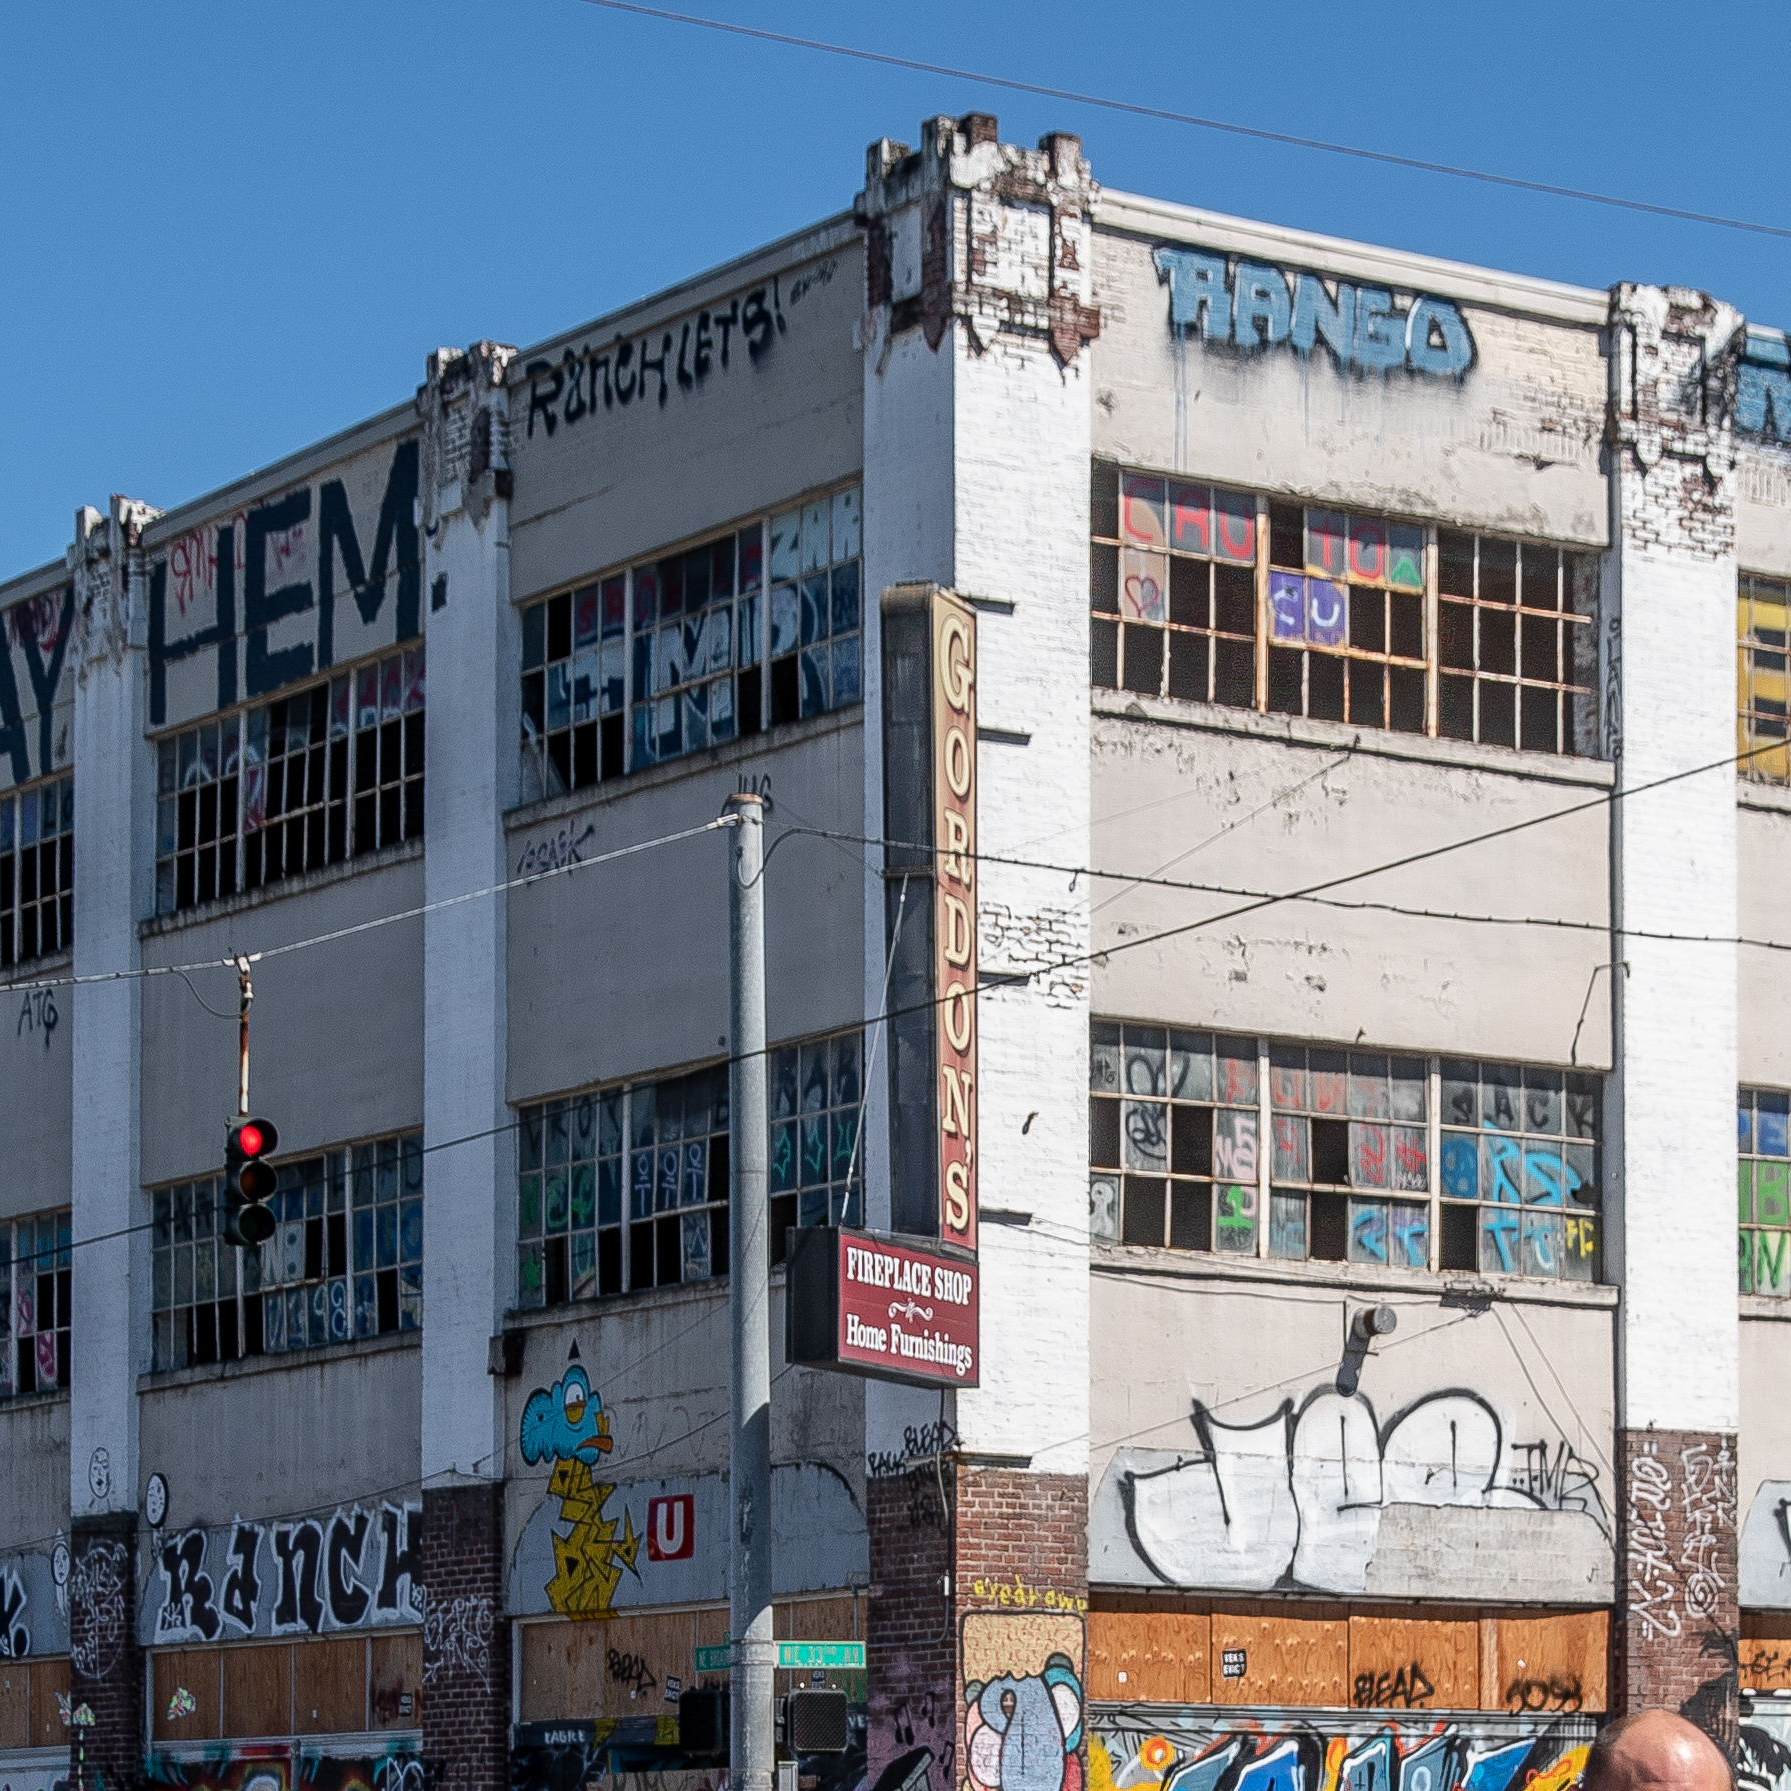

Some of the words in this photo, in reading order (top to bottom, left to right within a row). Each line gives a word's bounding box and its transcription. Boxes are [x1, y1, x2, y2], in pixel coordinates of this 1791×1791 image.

[938, 613, 975, 1231] GORDON'S
[846, 1246, 932, 1297] FIREPLACE
[934, 1266, 972, 1306] SHOP
[846, 1313, 887, 1352] Home
[890, 1323, 973, 1377] Furnishings
